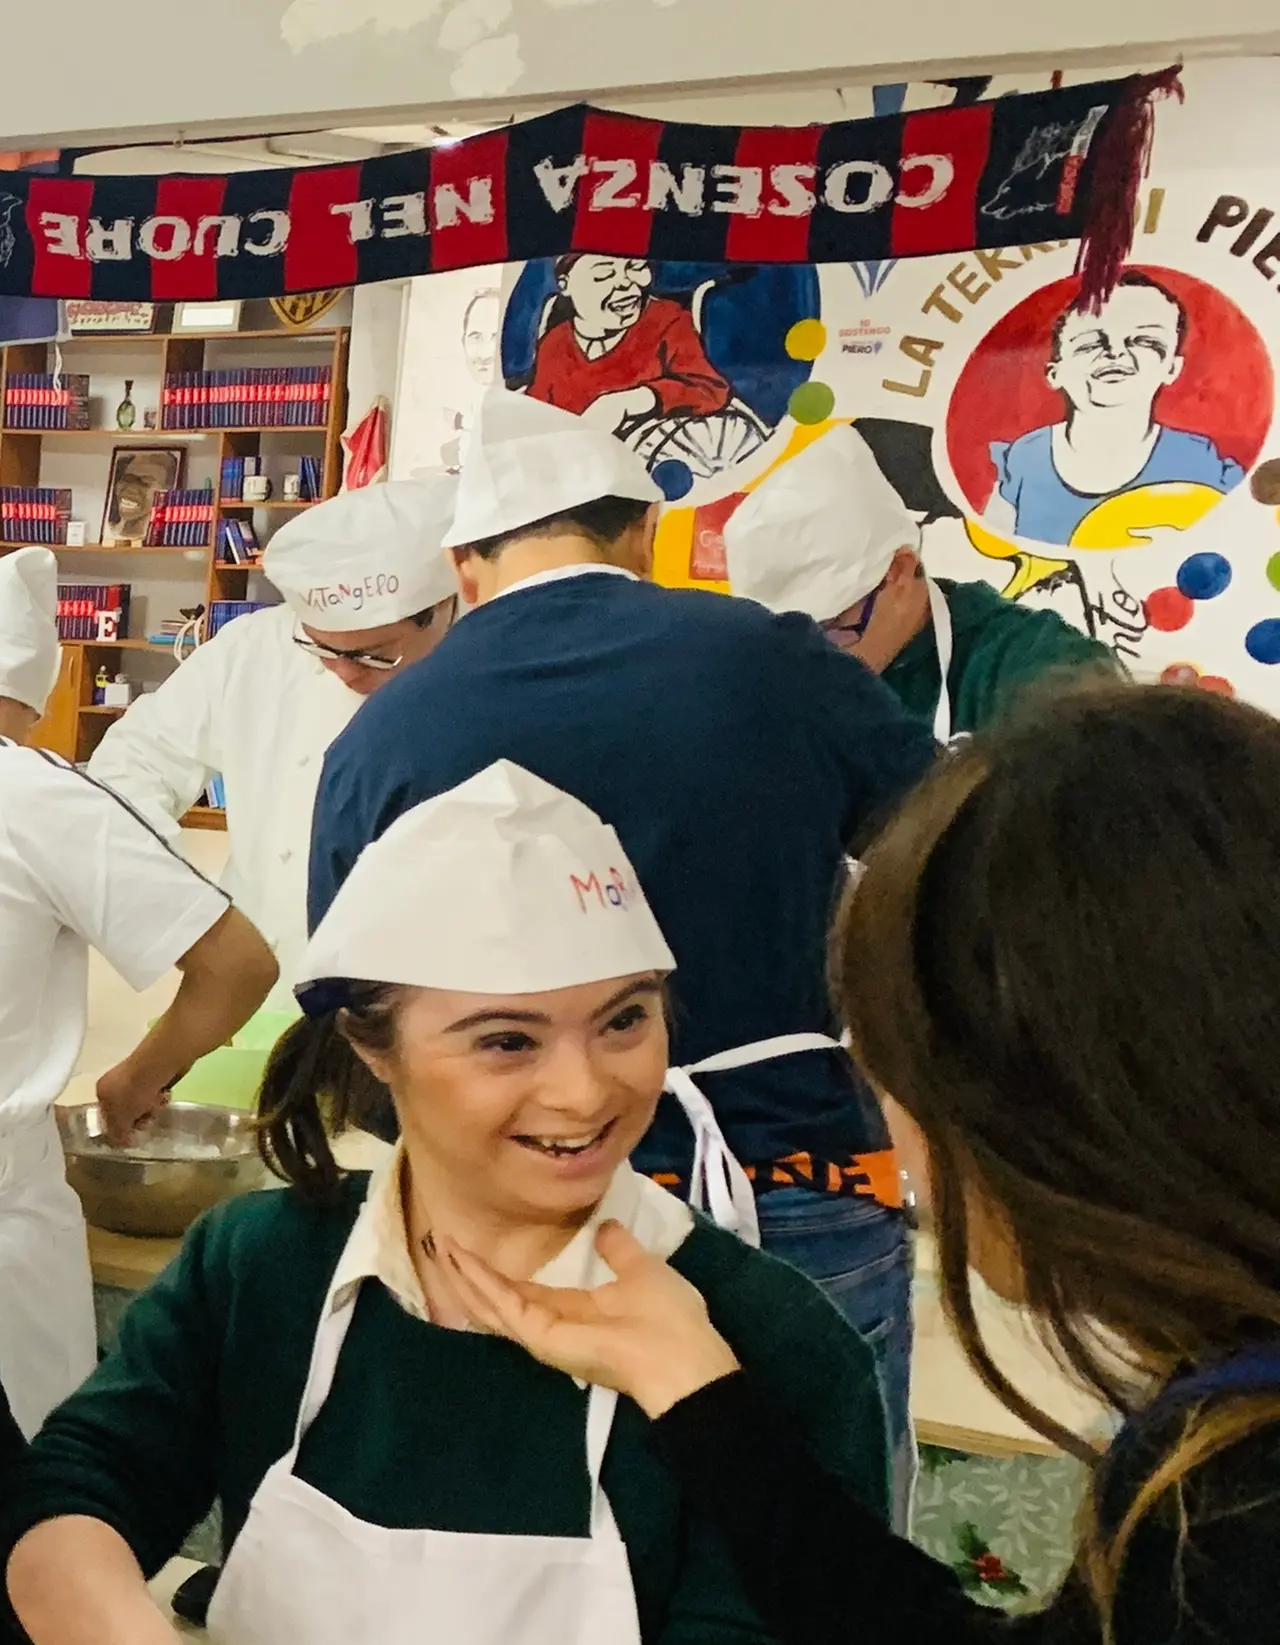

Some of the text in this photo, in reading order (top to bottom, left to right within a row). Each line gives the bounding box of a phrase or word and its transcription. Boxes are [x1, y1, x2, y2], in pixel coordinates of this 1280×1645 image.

[329, 176, 495, 244] NEL
[533, 153, 956, 219] COSENZA
[39, 207, 292, 262] CUORE
[882, 335, 944, 398] LA
[921, 239, 1070, 324] TER
[1196, 195, 1280, 293] PIE
[841, 344, 873, 354] PIERO
